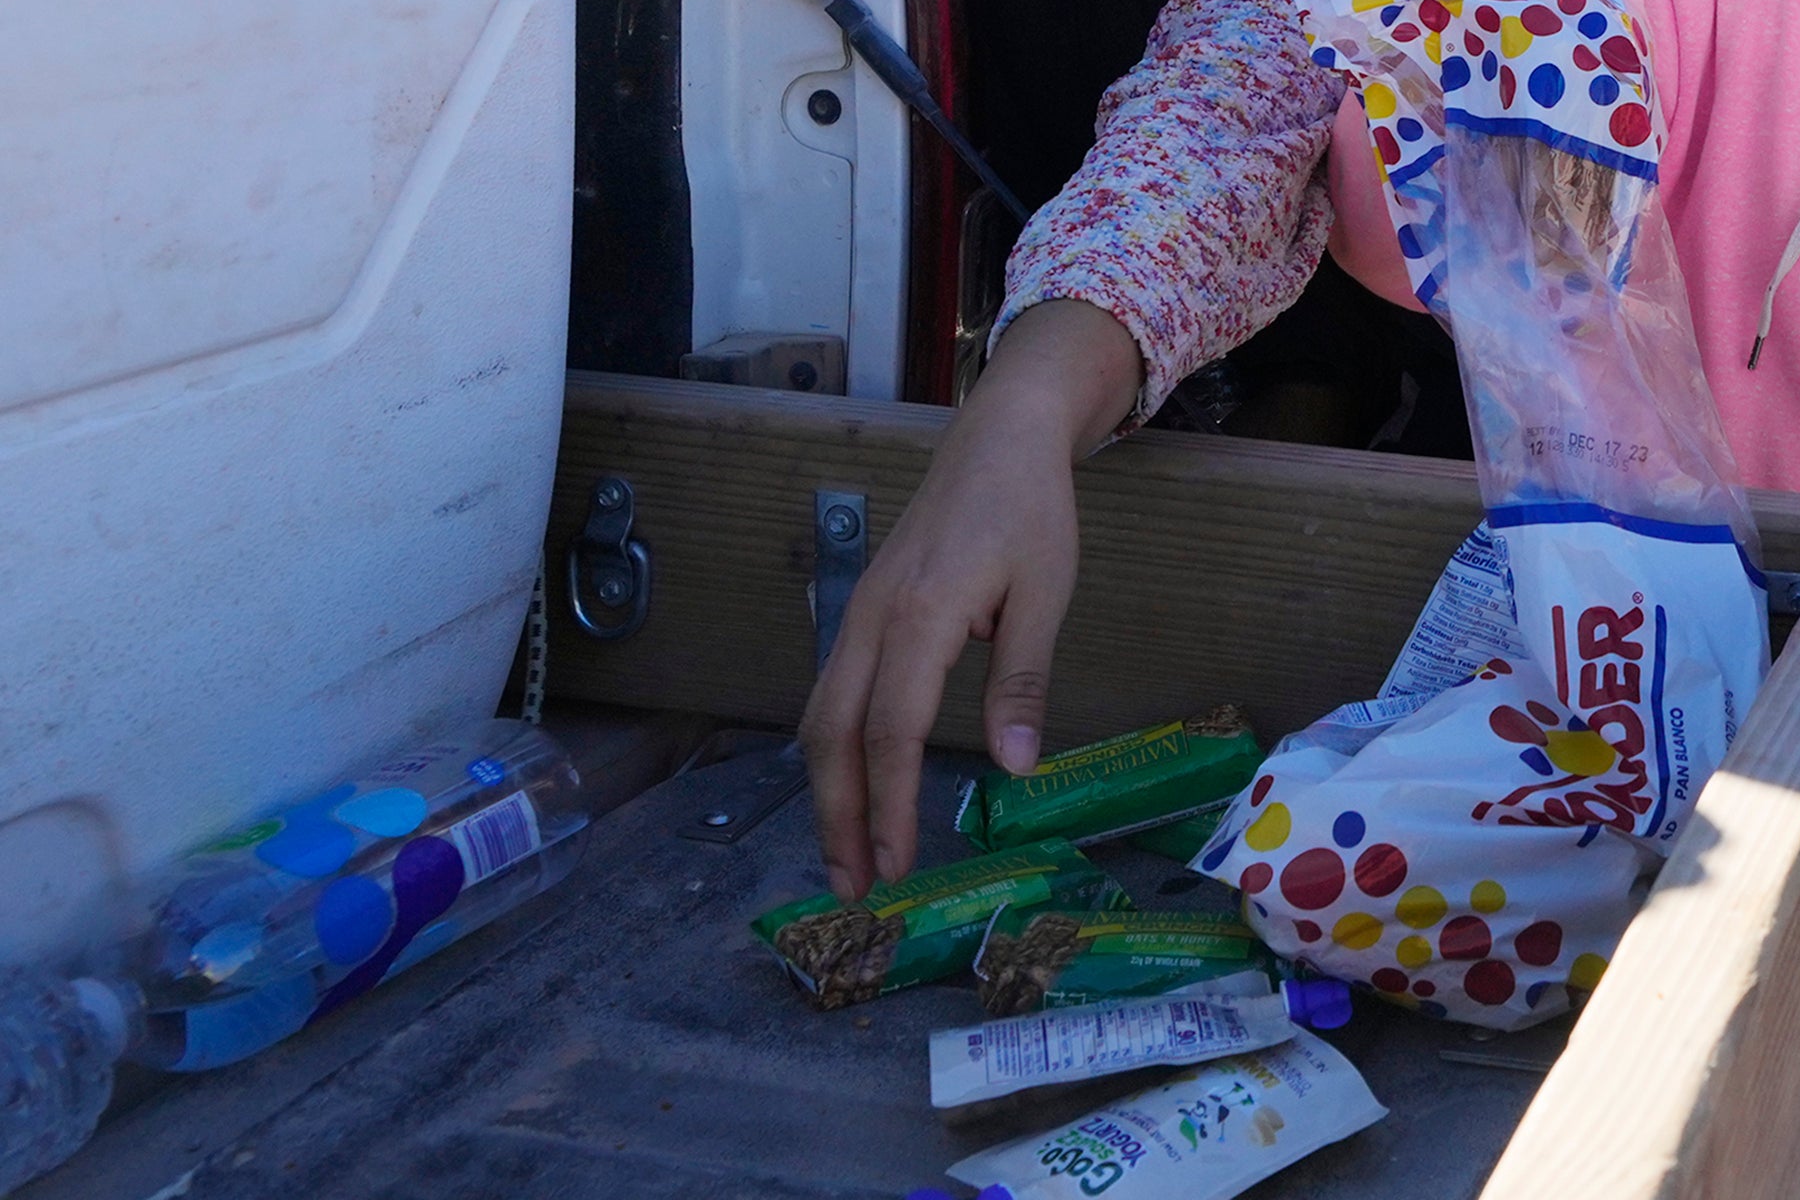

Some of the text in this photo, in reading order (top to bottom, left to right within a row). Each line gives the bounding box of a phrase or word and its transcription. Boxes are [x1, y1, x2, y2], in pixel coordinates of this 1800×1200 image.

[1568, 432, 1596, 451] DEC
[1604, 441, 1622, 457] 17
[1628, 445, 1650, 463] 23
[1459, 576, 1479, 590] Total
[1023, 734, 1180, 800] NATURE VALLEY
[1051, 737, 1146, 772] CRUNCHY
[1671, 707, 1690, 800] PAN BLANCO
[1125, 935, 1156, 944] OATS
[1180, 935, 1222, 945] HONEY
